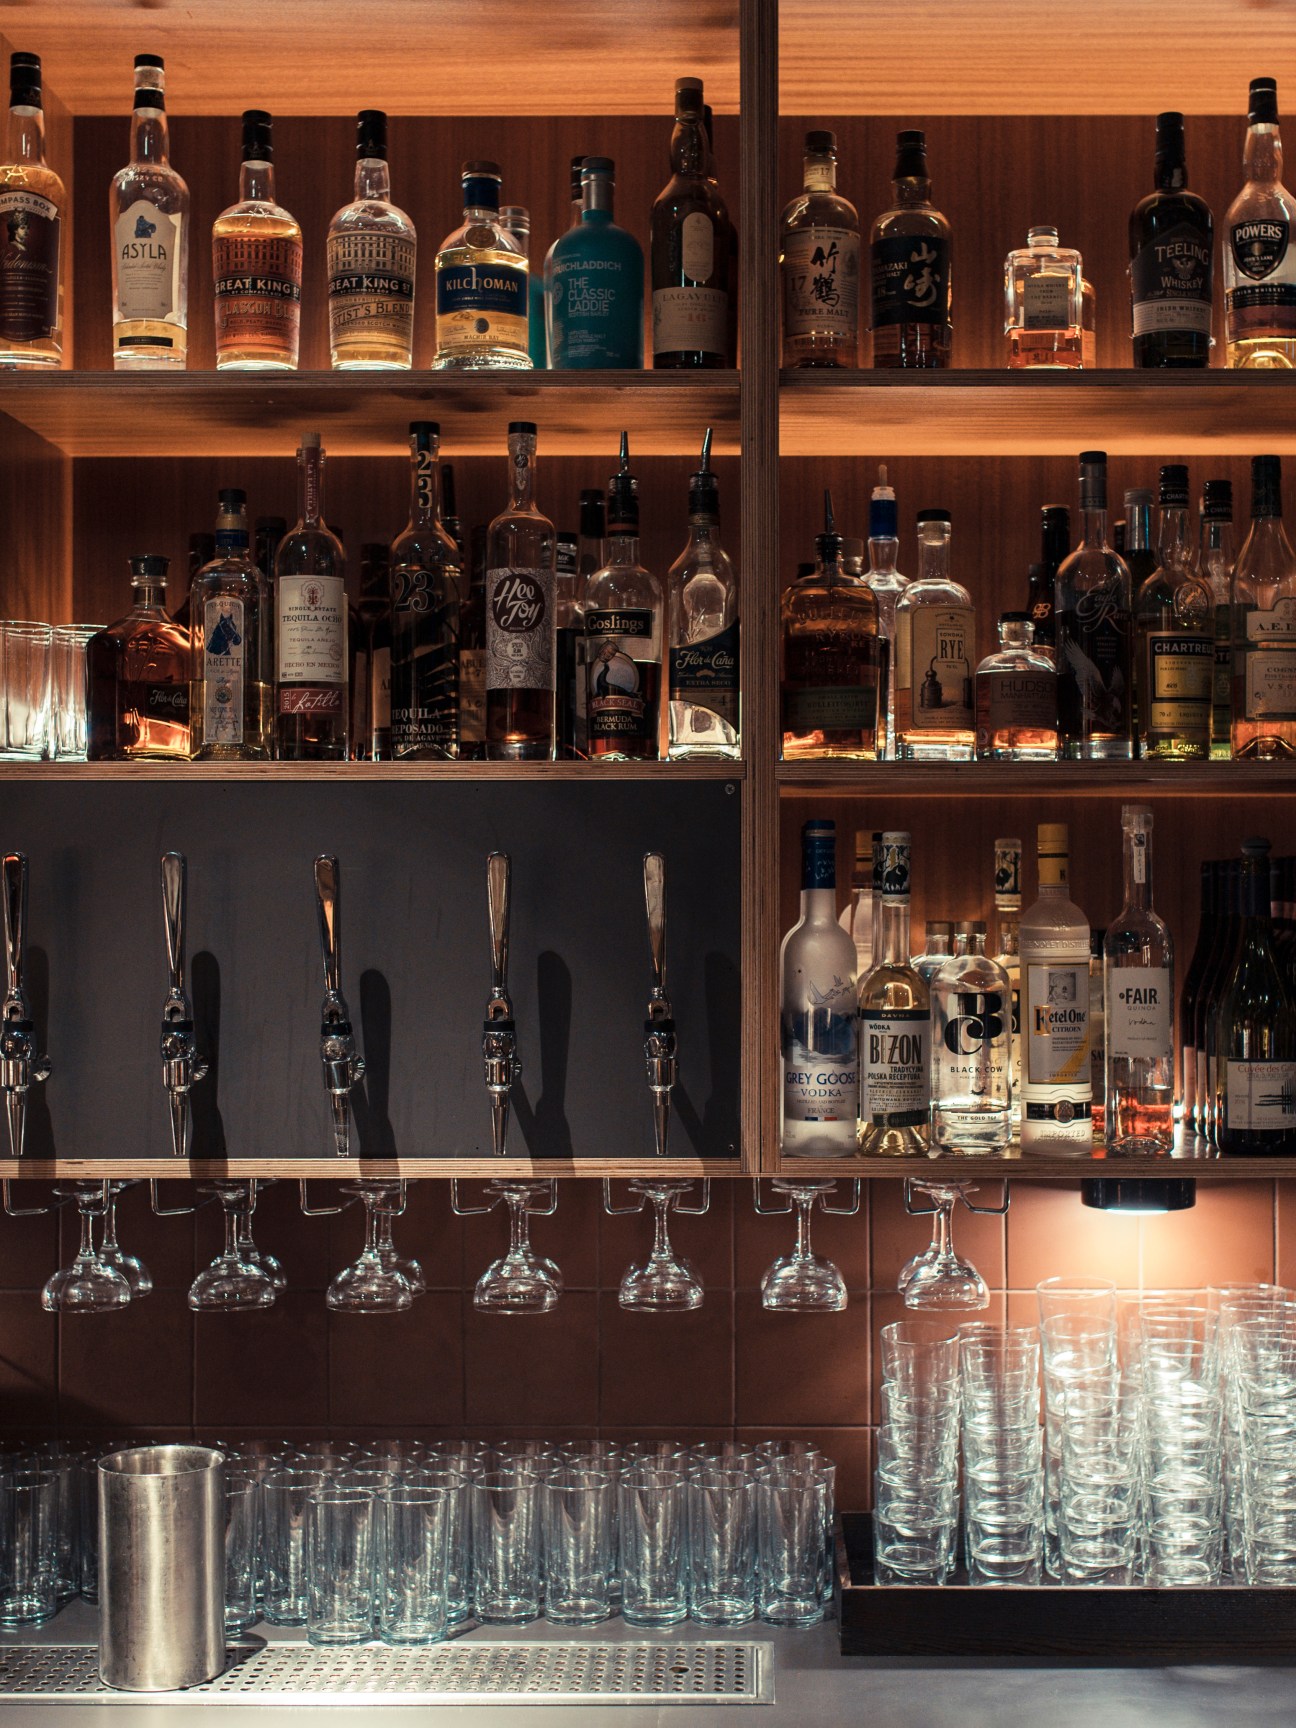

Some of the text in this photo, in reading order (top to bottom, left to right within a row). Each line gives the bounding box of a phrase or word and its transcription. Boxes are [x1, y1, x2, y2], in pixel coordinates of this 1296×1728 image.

[0, 196, 30, 205] MPASS
[33, 199, 50, 212] BOX
[1235, 224, 1282, 242] POWERS
[122, 243, 167, 260] ASYLA
[1154, 243, 1209, 265] TEELING
[215, 279, 250, 294] GREAT
[256, 279, 291, 294] KING
[363, 277, 399, 290] KING
[568, 277, 589, 290] THE
[1161, 276, 1203, 289] WHISKEY
[568, 288, 616, 301] CLASSIC
[376, 302, 410, 314] BLEND
[568, 300, 610, 313] LADDIE
[827, 309, 849, 317] MALT
[393, 571, 437, 613] 23
[494, 578, 535, 613] Hee
[282, 614, 341, 624] TEQUILA OCHO
[588, 614, 644, 634] Goslings
[940, 640, 964, 659] RYE
[206, 658, 241, 667] ARETTE
[676, 651, 703, 669] Flor
[712, 651, 734, 669] Caña
[1001, 680, 1053, 692] HUDSO
[617, 699, 637, 708] SEAL
[392, 708, 440, 721] TEQUILA
[597, 715, 632, 723] BERMUDA
[392, 723, 443, 734] REPOSADO
[594, 723, 637, 731] BLACK RUM
[869, 1023, 890, 1031] WÓDKA
[1036, 1008, 1086, 1034] Ketel One
[1237, 1063, 1280, 1073] Cuvée des
[786, 1069, 856, 1085] GREY GOOSE
[868, 1072, 921, 1081] POLSKA RECEPTURA
[801, 1088, 842, 1097] VODKA
